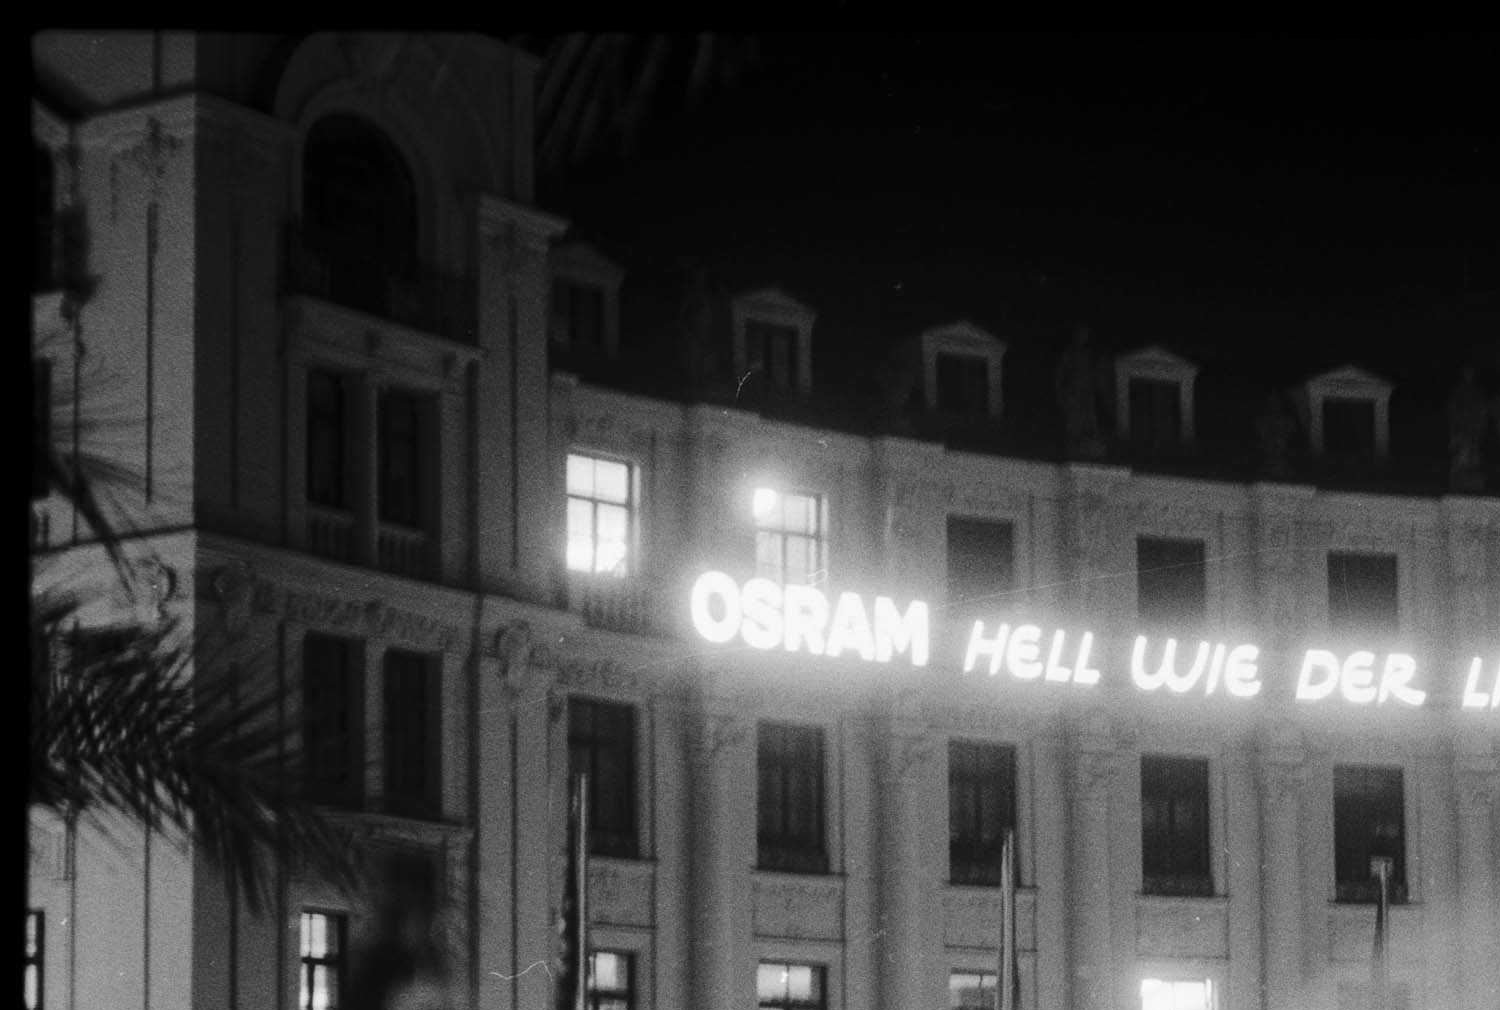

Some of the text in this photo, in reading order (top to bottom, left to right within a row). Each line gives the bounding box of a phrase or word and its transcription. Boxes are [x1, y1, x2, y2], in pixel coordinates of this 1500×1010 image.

[690, 571, 929, 666] OSRAM
[964, 620, 1100, 686] HELL
[1131, 636, 1261, 697] WIE
[1296, 650, 1426, 705] DER
